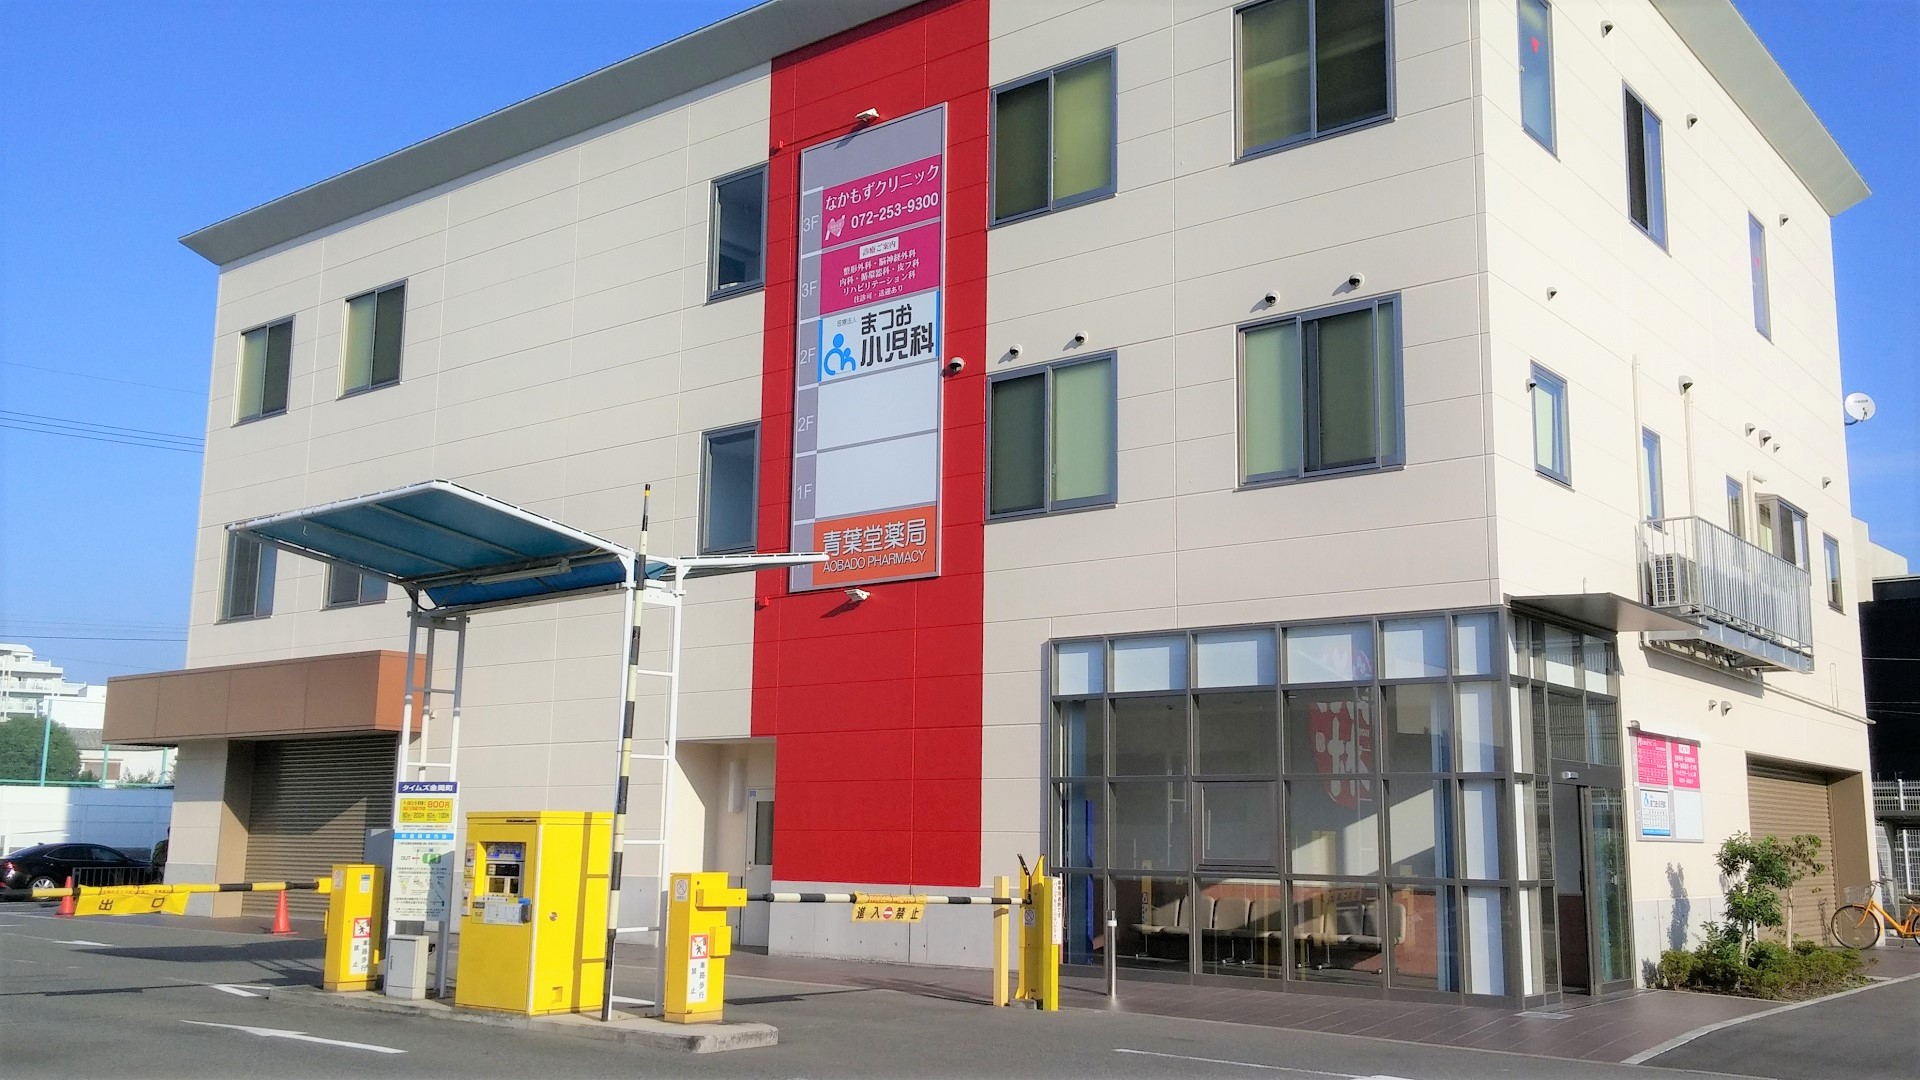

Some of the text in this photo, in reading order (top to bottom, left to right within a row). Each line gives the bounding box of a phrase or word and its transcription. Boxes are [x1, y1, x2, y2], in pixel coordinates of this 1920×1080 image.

[825, 164, 939, 211] なかもずクリニック
[803, 214, 819, 232] 3F
[851, 192, 939, 229] 072-253-9300
[801, 280, 818, 298] 3F
[843, 269, 916, 296] リハビリテーション科
[861, 303, 912, 335] まつお
[799, 347, 817, 365] 2F
[860, 322, 934, 367] 小児科
[797, 414, 815, 432] 2F
[796, 483, 813, 500] 1F
[822, 518, 927, 557] 青葉堂薬局
[822, 549, 926, 573] AOBADO PHARMACY
